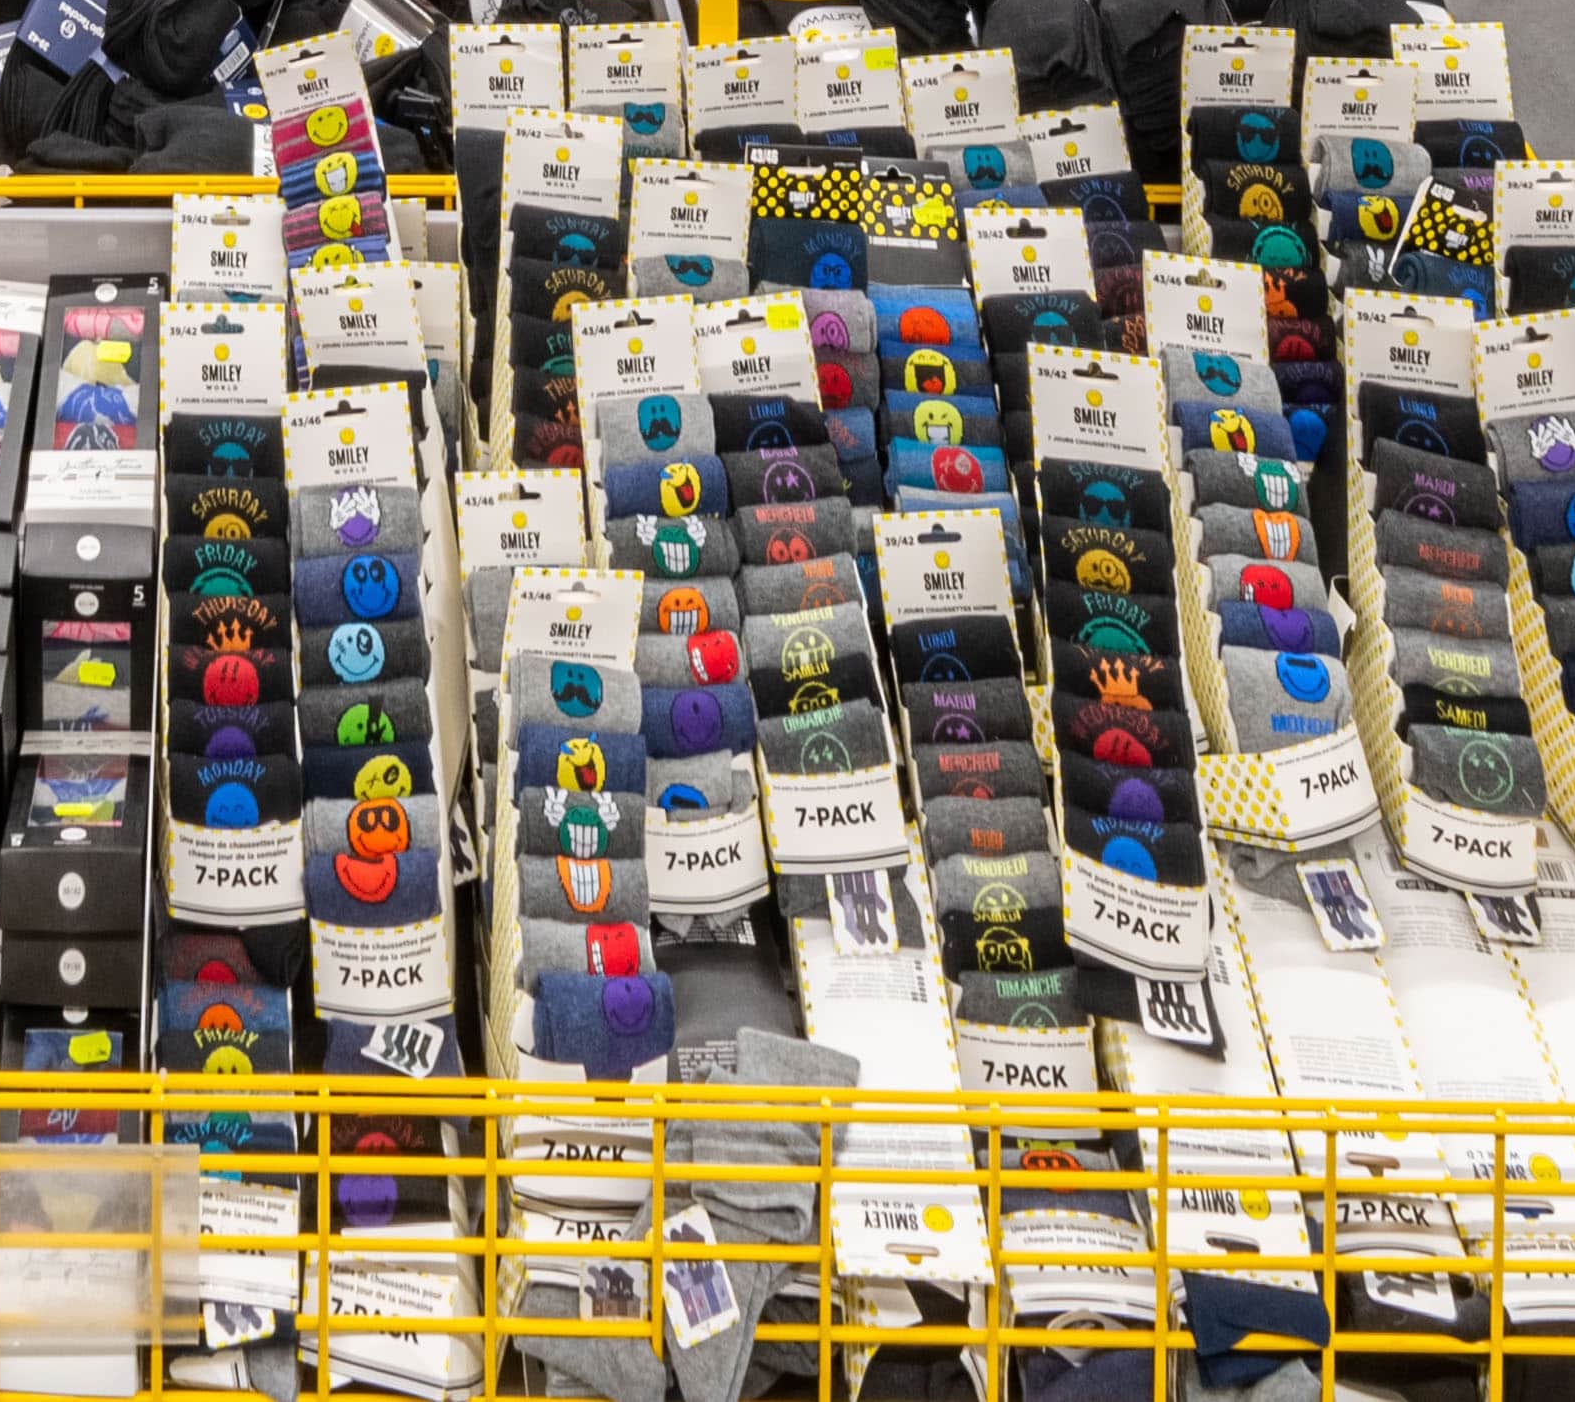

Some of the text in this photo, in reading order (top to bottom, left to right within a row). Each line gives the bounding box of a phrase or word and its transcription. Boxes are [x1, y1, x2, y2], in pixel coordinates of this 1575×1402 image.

[1218, 71, 1254, 88] SMILEY
[945, 102, 980, 120] SMILEY
[516, 128, 542, 138] 39/42
[170, 325, 198, 336] 39/42
[583, 325, 611, 336] 43/46
[201, 364, 241, 384] SMILEY
[617, 356, 656, 374] SMILEY
[732, 356, 771, 375] SMILEY
[291, 416, 321, 428] 43/46
[199, 421, 267, 446] SUNDAY
[329, 447, 369, 466] SMILEY
[190, 492, 270, 526] SATURDAY
[194, 544, 258, 570] FRIDAY
[923, 570, 967, 592] SMILEY
[191, 597, 279, 632] THURSDAY
[197, 761, 267, 785] MONDAY
[1299, 760, 1358, 799] 7-PACK
[794, 802, 876, 829] 7-PACK
[665, 841, 741, 871] 7-PACK
[195, 864, 279, 887] 7-PACK
[339, 966, 424, 990] 7-PACK
[981, 1059, 1067, 1089] 7-PACK
